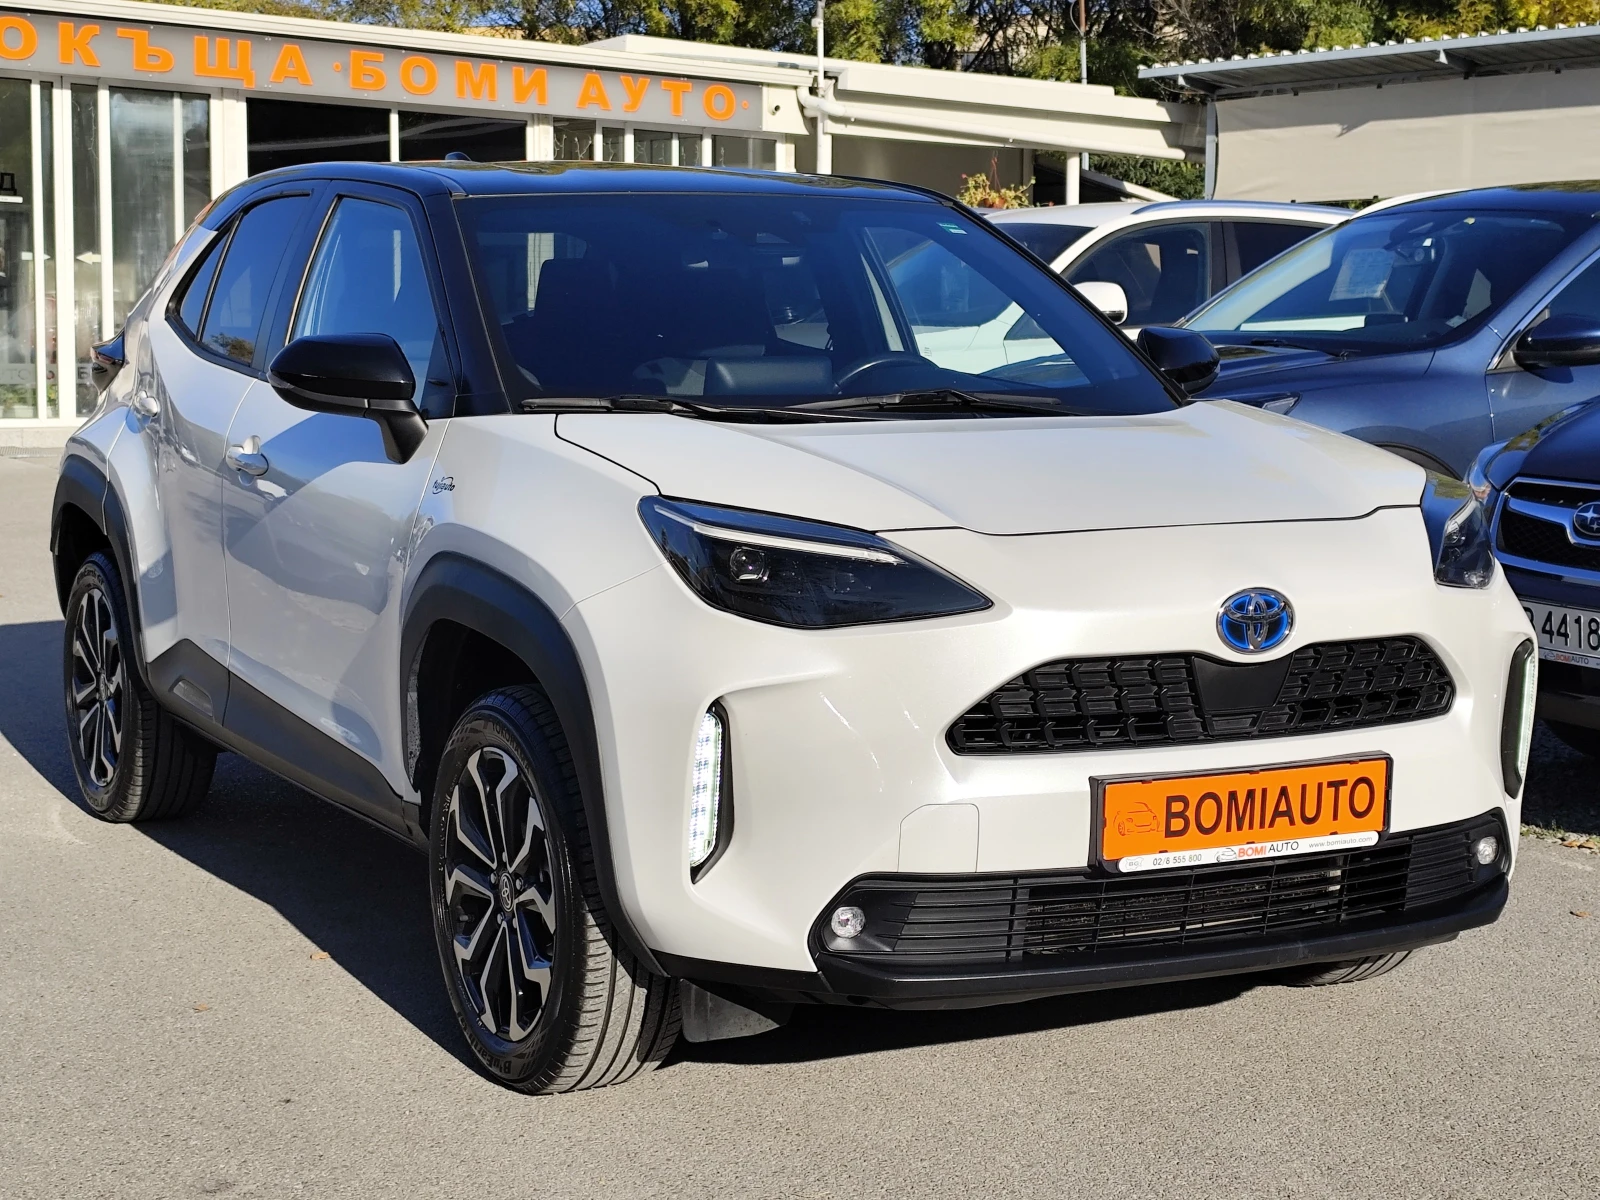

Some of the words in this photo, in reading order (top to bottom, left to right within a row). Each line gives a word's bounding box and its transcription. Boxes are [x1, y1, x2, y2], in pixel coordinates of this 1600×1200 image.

[350, 50, 548, 105] БОМИ
[576, 73, 737, 121] АУТО
[1541, 611, 1600, 650] 4418
[1164, 776, 1375, 838] BOMIAUTO
[1238, 845, 1267, 858] BOMI
[1268, 841, 1299, 853] AUTO
[1309, 836, 1373, 849] www.bomiauto.com
